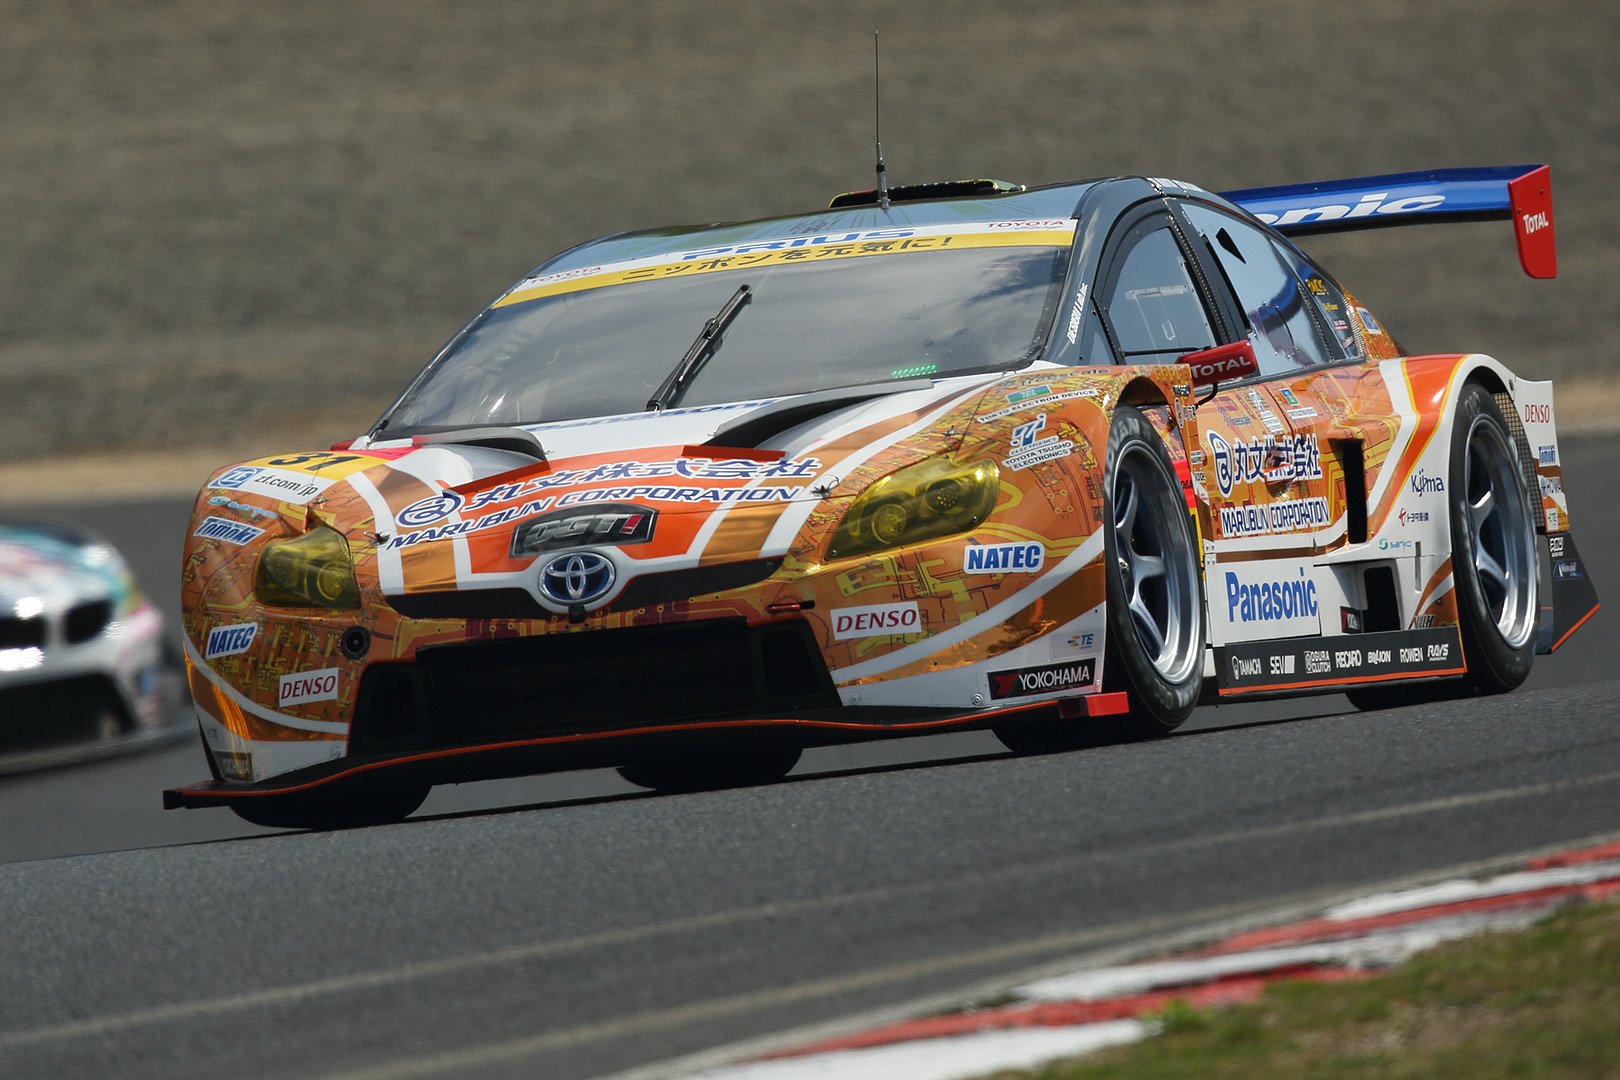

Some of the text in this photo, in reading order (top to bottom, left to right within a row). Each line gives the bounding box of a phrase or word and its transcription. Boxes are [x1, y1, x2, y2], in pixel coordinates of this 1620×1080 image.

[987, 219, 1065, 229] TOYOTA
[1522, 211, 1549, 235] TOTAL
[682, 229, 916, 260] PRIUS
[530, 266, 602, 284] TOYOTA
[1191, 356, 1251, 379] TOTAL
[980, 389, 1096, 421] TOKYO ELECTRON DEVICE
[1525, 404, 1550, 423] DENSO
[268, 452, 362, 471] 31
[1005, 441, 1072, 465] TOYOTA TSUSHO
[1013, 449, 1069, 469] ELECTRONICS
[253, 474, 319, 497] zf.com/jp
[462, 459, 818, 511] 丸文株式会社
[386, 486, 801, 550] MARUBUN CORPORATION
[1222, 500, 1330, 534] MARUBUN CORPORATION
[968, 545, 1041, 569] NATEC
[1225, 566, 1318, 623] Panasonic
[836, 608, 917, 633] DENSO
[208, 626, 255, 656] NATEC
[1081, 633, 1095, 646] TE
[1270, 656, 1285, 675] SEV
[1335, 649, 1362, 668] RECARO
[1400, 647, 1424, 663] ROWEN
[281, 675, 337, 700] DENSO
[1019, 665, 1090, 690] YOKOHAMA
